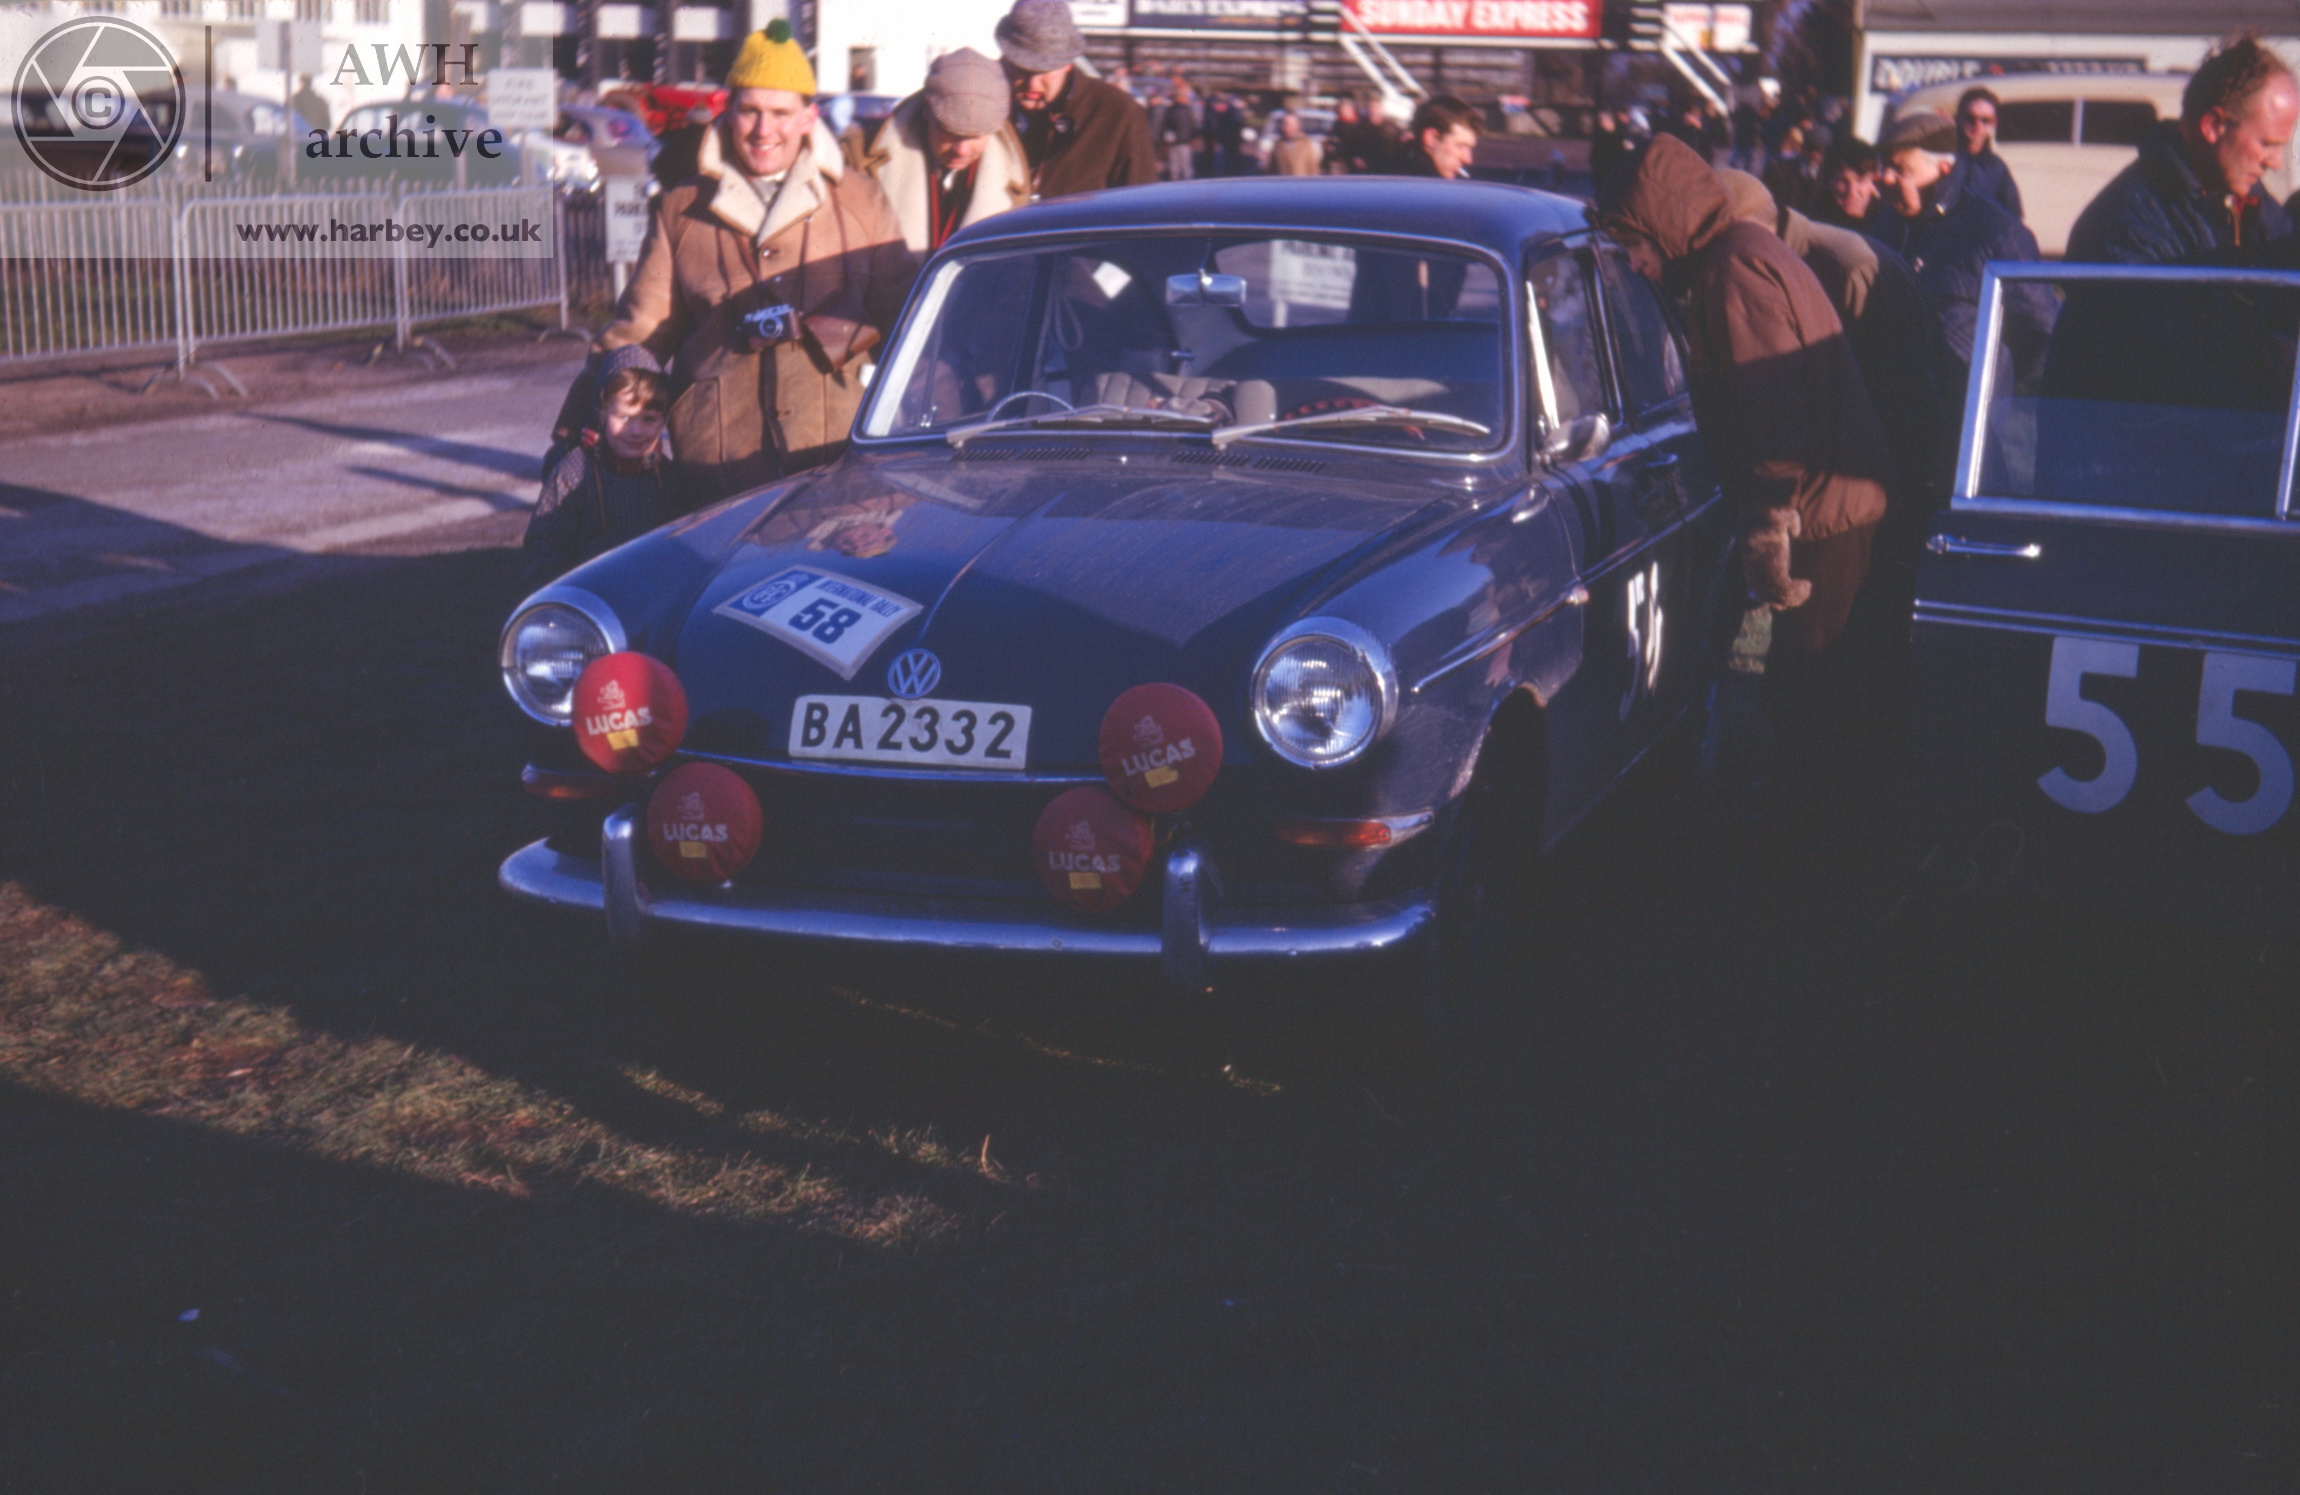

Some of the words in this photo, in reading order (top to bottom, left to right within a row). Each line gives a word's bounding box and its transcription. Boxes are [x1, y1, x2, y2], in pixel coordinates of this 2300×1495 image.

[1357, 0, 1468, 28] SUNDAY
[1470, 2, 1589, 32] EXPRESS
[788, 597, 862, 645] 58
[868, 599, 905, 619] RALLY
[586, 706, 653, 735] LUCAS
[2036, 635, 2298, 836] 55
[1121, 738, 1197, 777] LUCAS
[662, 823, 729, 843] LUCAS
[1049, 851, 1121, 874] LUCAS
